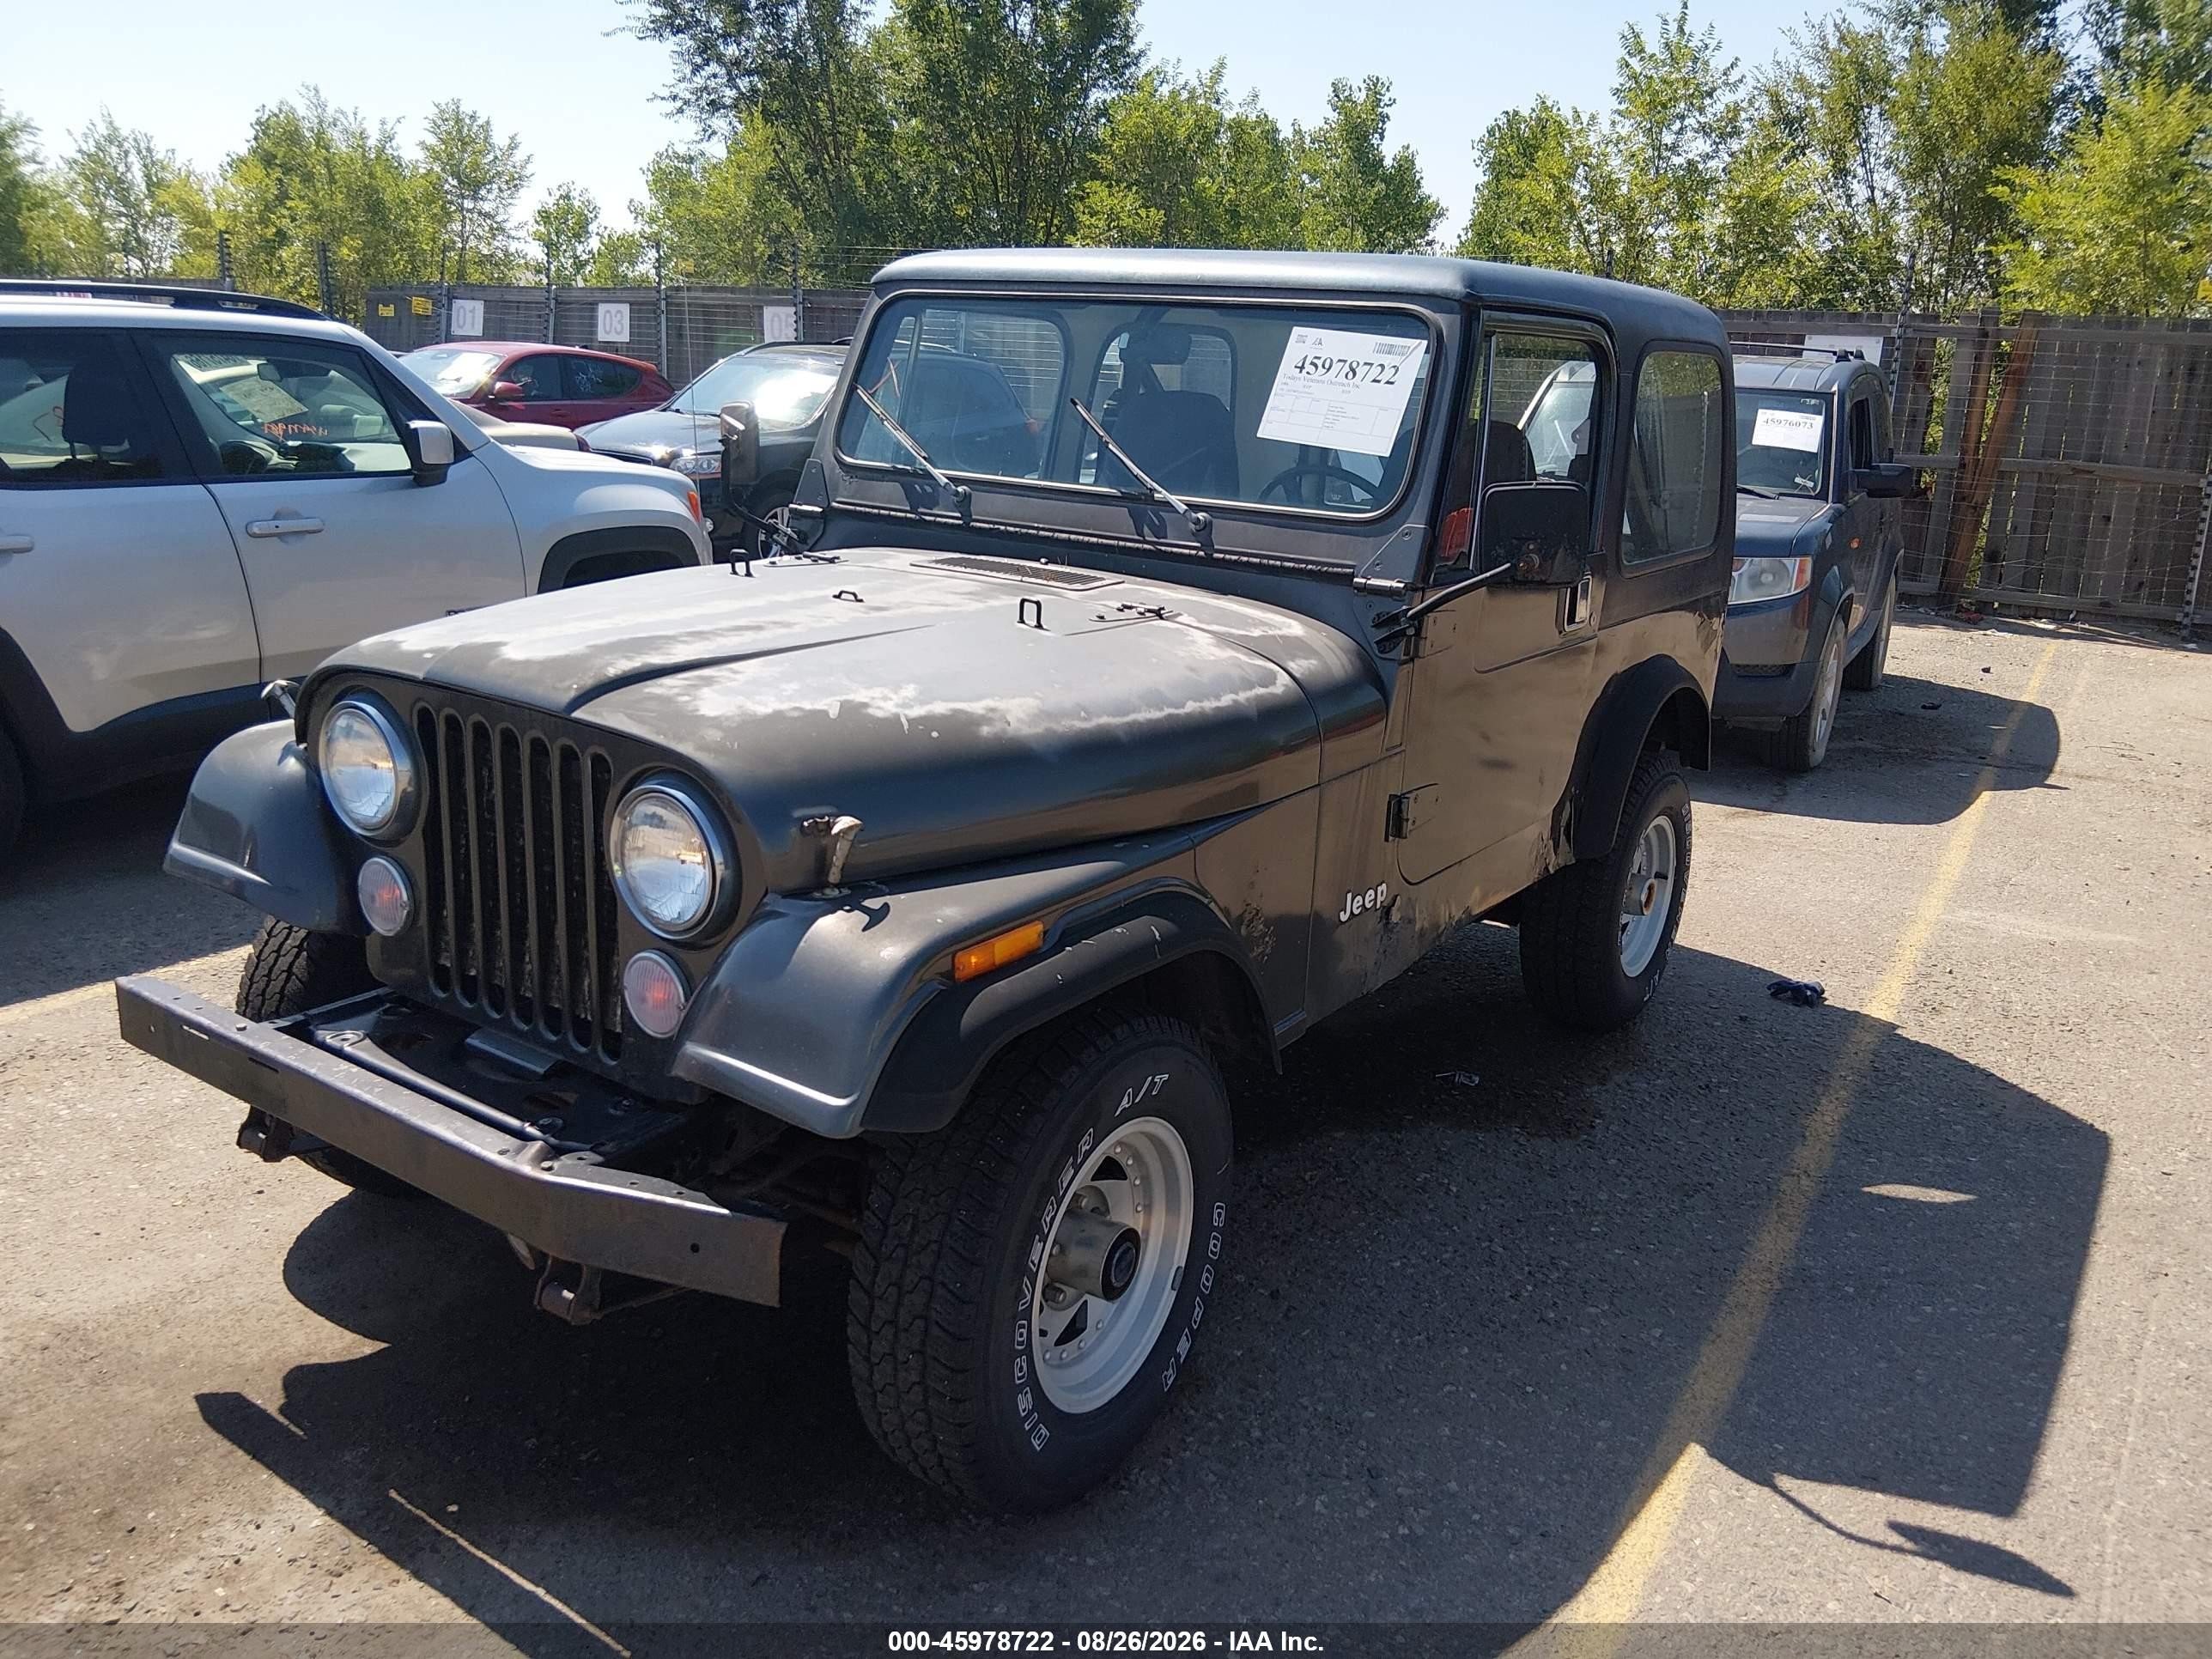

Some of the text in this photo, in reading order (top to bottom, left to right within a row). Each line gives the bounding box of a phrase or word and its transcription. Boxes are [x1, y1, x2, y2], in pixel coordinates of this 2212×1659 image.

[456, 305, 476, 329] 01
[603, 309, 624, 335] 03
[1294, 354, 1400, 386] 45978722
[1762, 417, 1814, 430] 45976073
[1340, 882, 1388, 922] Jeep
[1014, 1073, 1169, 1451] DISCOVERER A/T
[1162, 1202, 1225, 1392] COOPER
